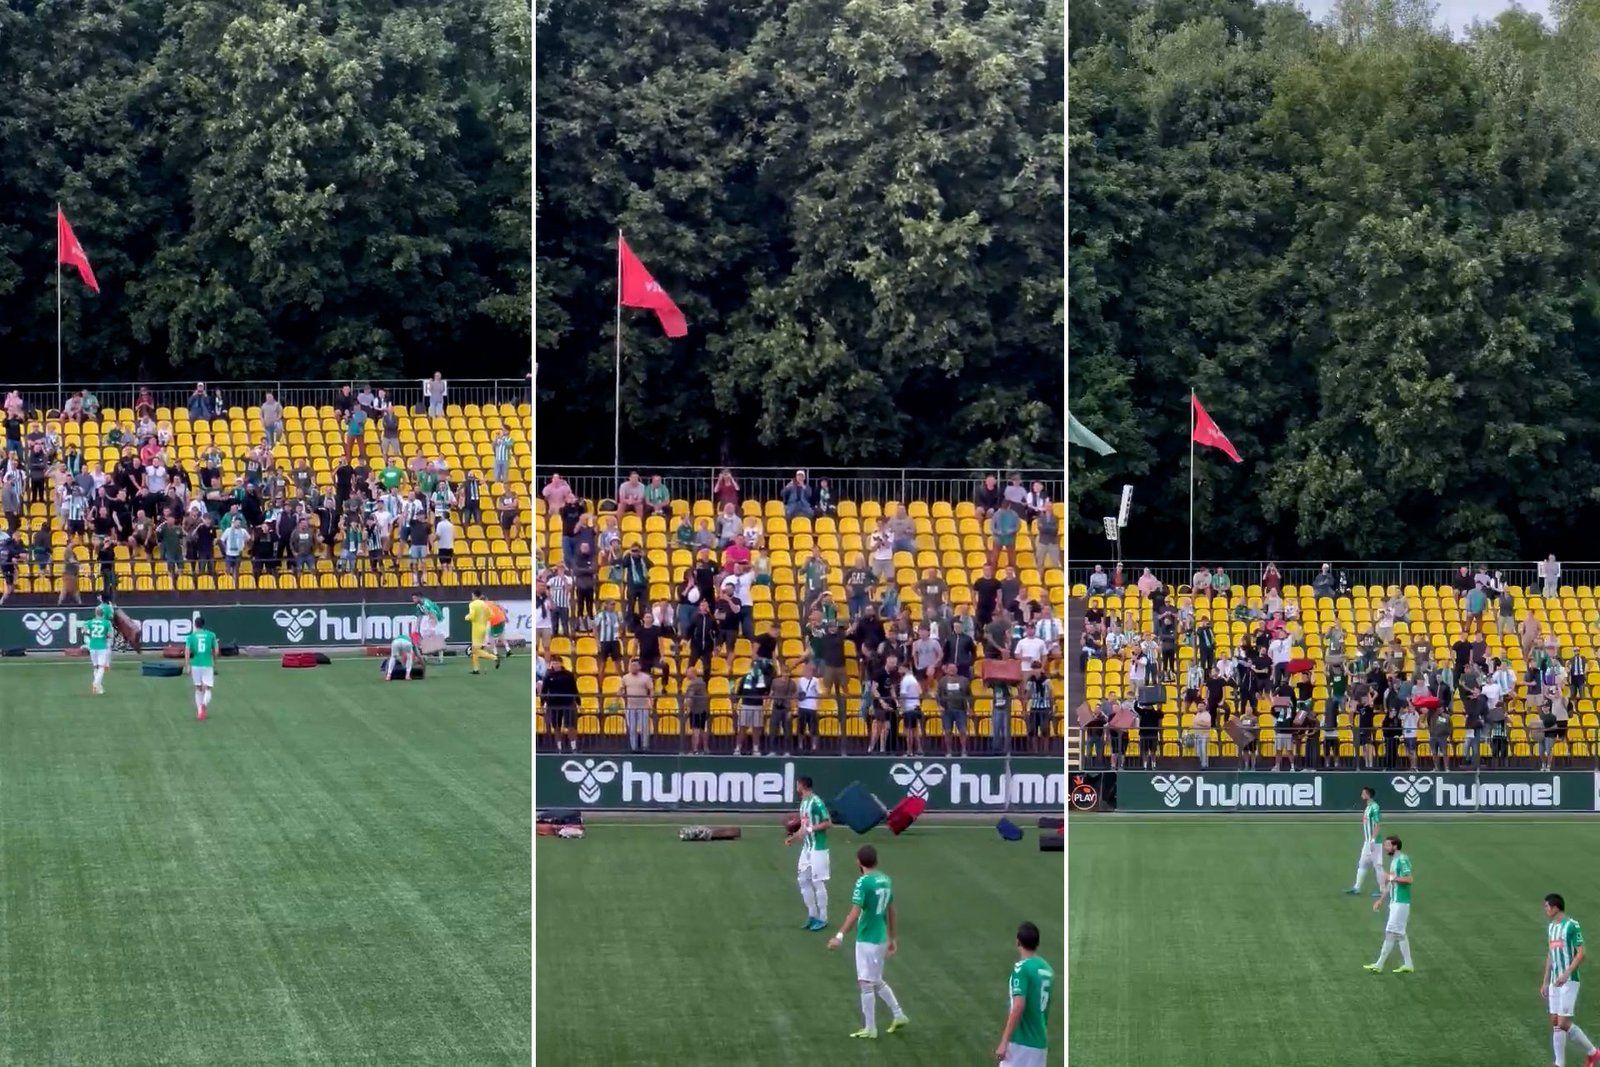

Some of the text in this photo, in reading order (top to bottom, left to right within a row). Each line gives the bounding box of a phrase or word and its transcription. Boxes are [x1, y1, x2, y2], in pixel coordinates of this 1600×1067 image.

[91, 624, 105, 638] 22
[622, 761, 795, 803] hummel
[1196, 776, 1322, 806] hummel
[1435, 776, 1561, 806] hummel
[1074, 793, 1095, 802] PLAY
